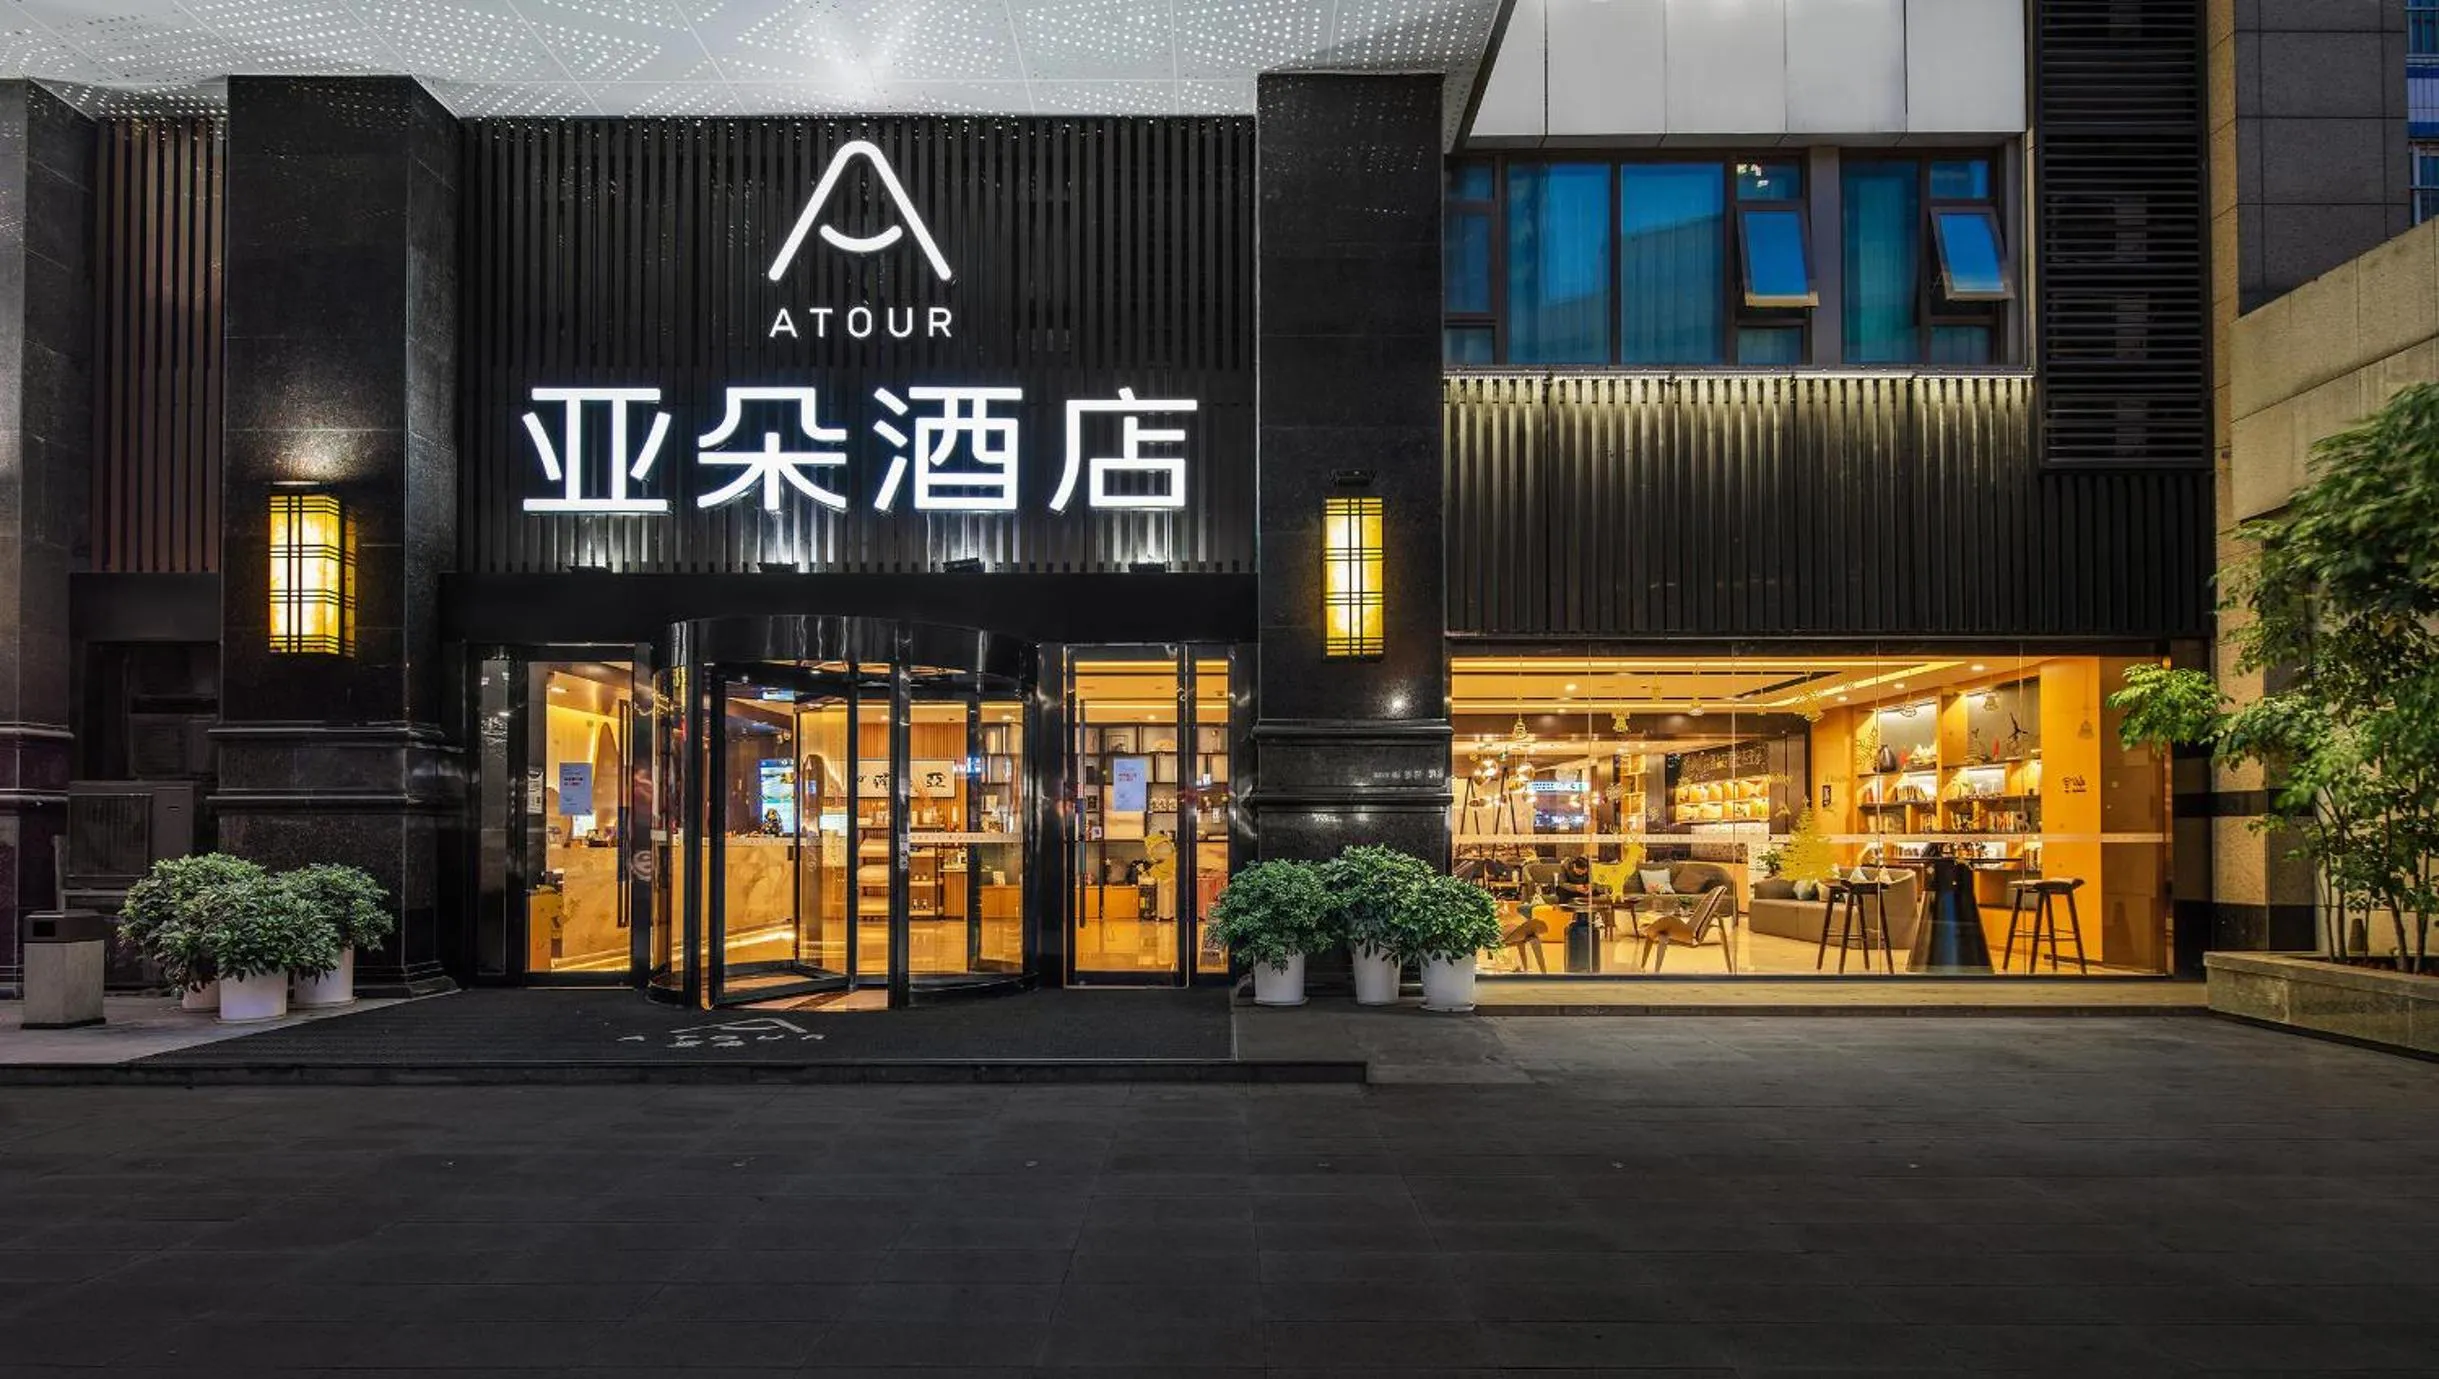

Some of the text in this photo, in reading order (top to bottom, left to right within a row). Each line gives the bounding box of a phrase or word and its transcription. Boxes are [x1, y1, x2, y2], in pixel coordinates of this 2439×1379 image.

[769, 307, 952, 338] ATOUR
[522, 387, 1198, 512] 亚朵酒店
